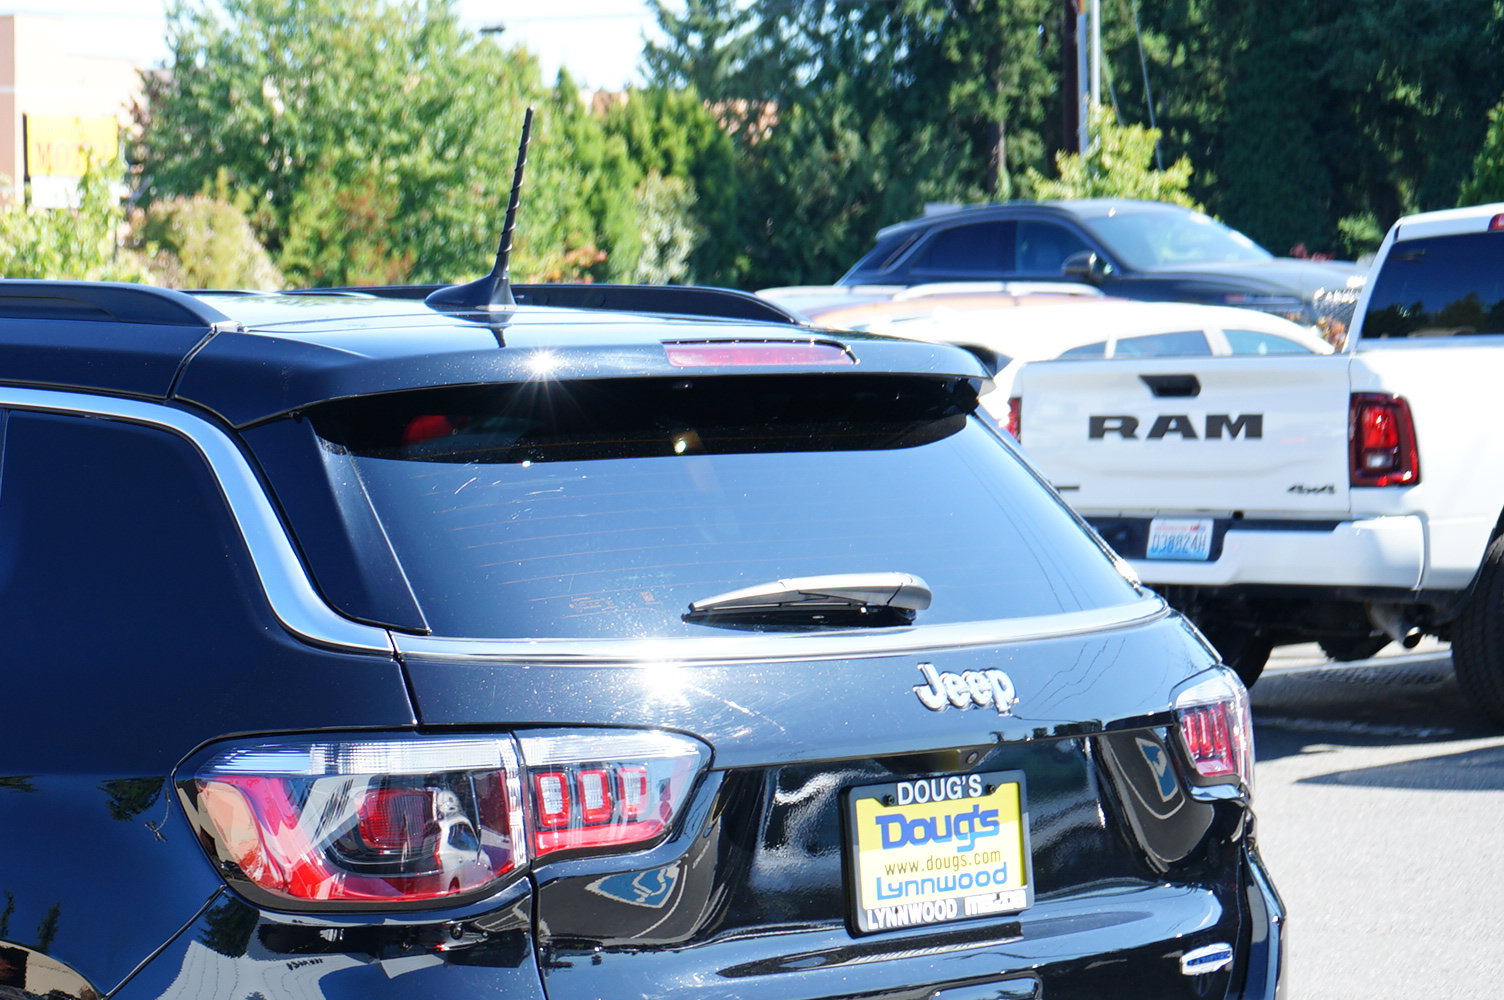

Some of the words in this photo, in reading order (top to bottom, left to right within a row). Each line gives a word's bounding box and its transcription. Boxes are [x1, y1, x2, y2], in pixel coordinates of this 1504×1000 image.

[1088, 414, 1263, 440] RAM
[912, 661, 1019, 717] Jeep
[897, 774, 983, 806] DOUG'S
[884, 850, 1002, 876] www.dougs.com
[876, 861, 1008, 901] Lynnwood
[867, 898, 958, 931] LYNNWOOD
